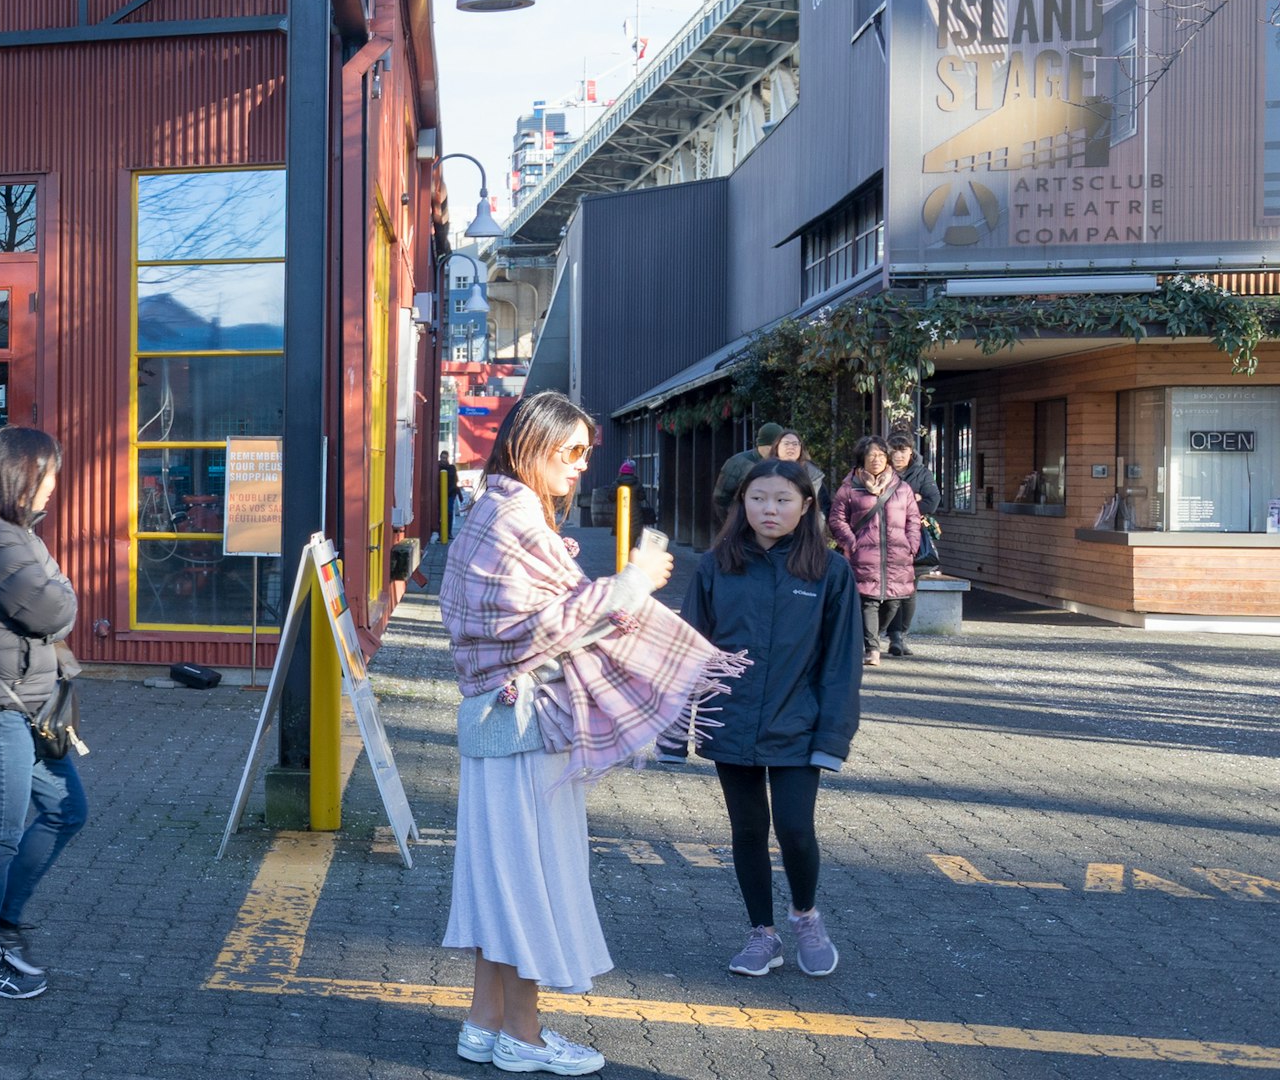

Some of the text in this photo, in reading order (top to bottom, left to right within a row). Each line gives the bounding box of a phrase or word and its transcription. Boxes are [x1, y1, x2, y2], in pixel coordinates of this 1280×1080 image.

[936, 47, 1103, 112] STAGE
[1014, 174, 1164, 193] ARTSCLUB
[1015, 199, 1163, 218] THEATRE
[1015, 225, 1163, 244] COMPANY
[1191, 432, 1254, 450] OPEN
[230, 452, 282, 461] REMEMBER
[230, 462, 255, 471] YOUR
[230, 472, 278, 482] SHOPPING
[229, 493, 278, 502] N'OUBLIEZ
[229, 504, 247, 512] PAS
[249, 504, 266, 512] VOS
